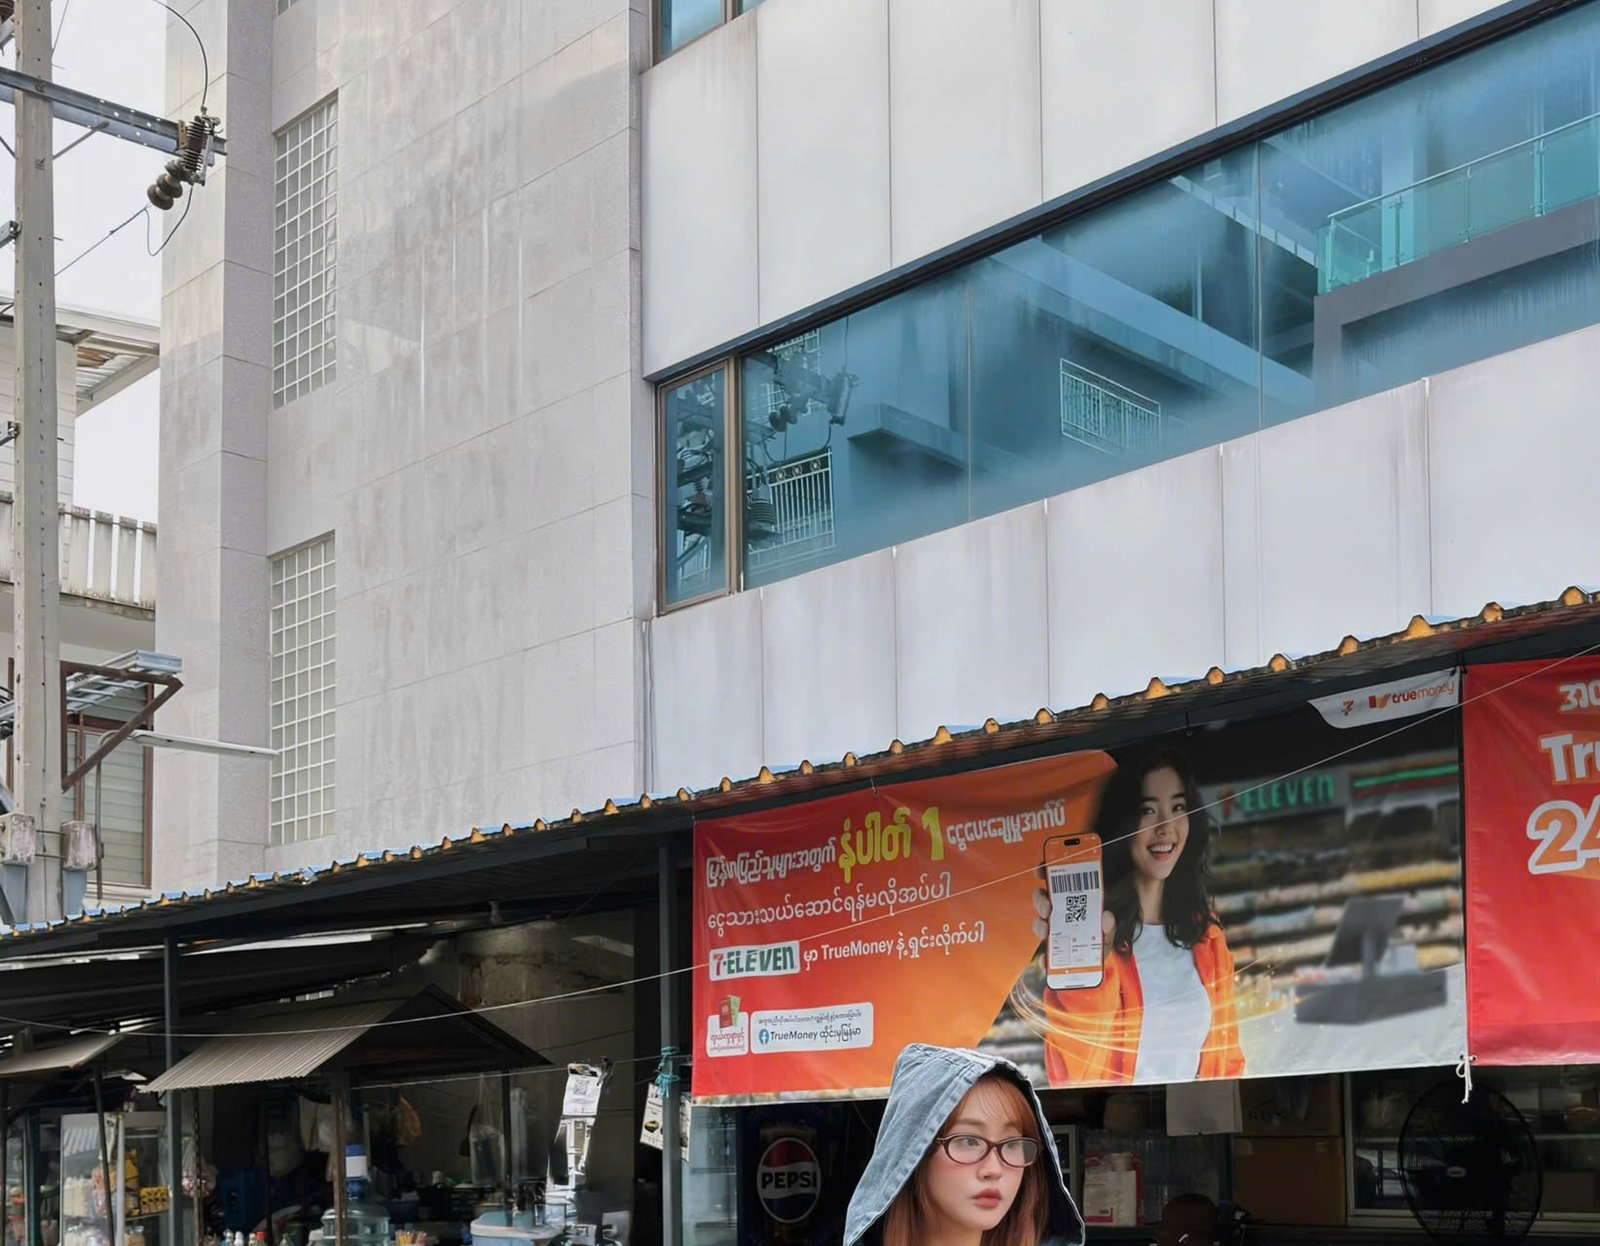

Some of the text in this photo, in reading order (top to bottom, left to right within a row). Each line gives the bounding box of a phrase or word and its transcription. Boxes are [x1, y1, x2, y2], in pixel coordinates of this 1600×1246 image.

[921, 806, 944, 861] 1
[821, 939, 894, 960] TrueMoney
[770, 1030, 818, 1041] TrueMoney
[761, 1171, 817, 1189] PEPSI
